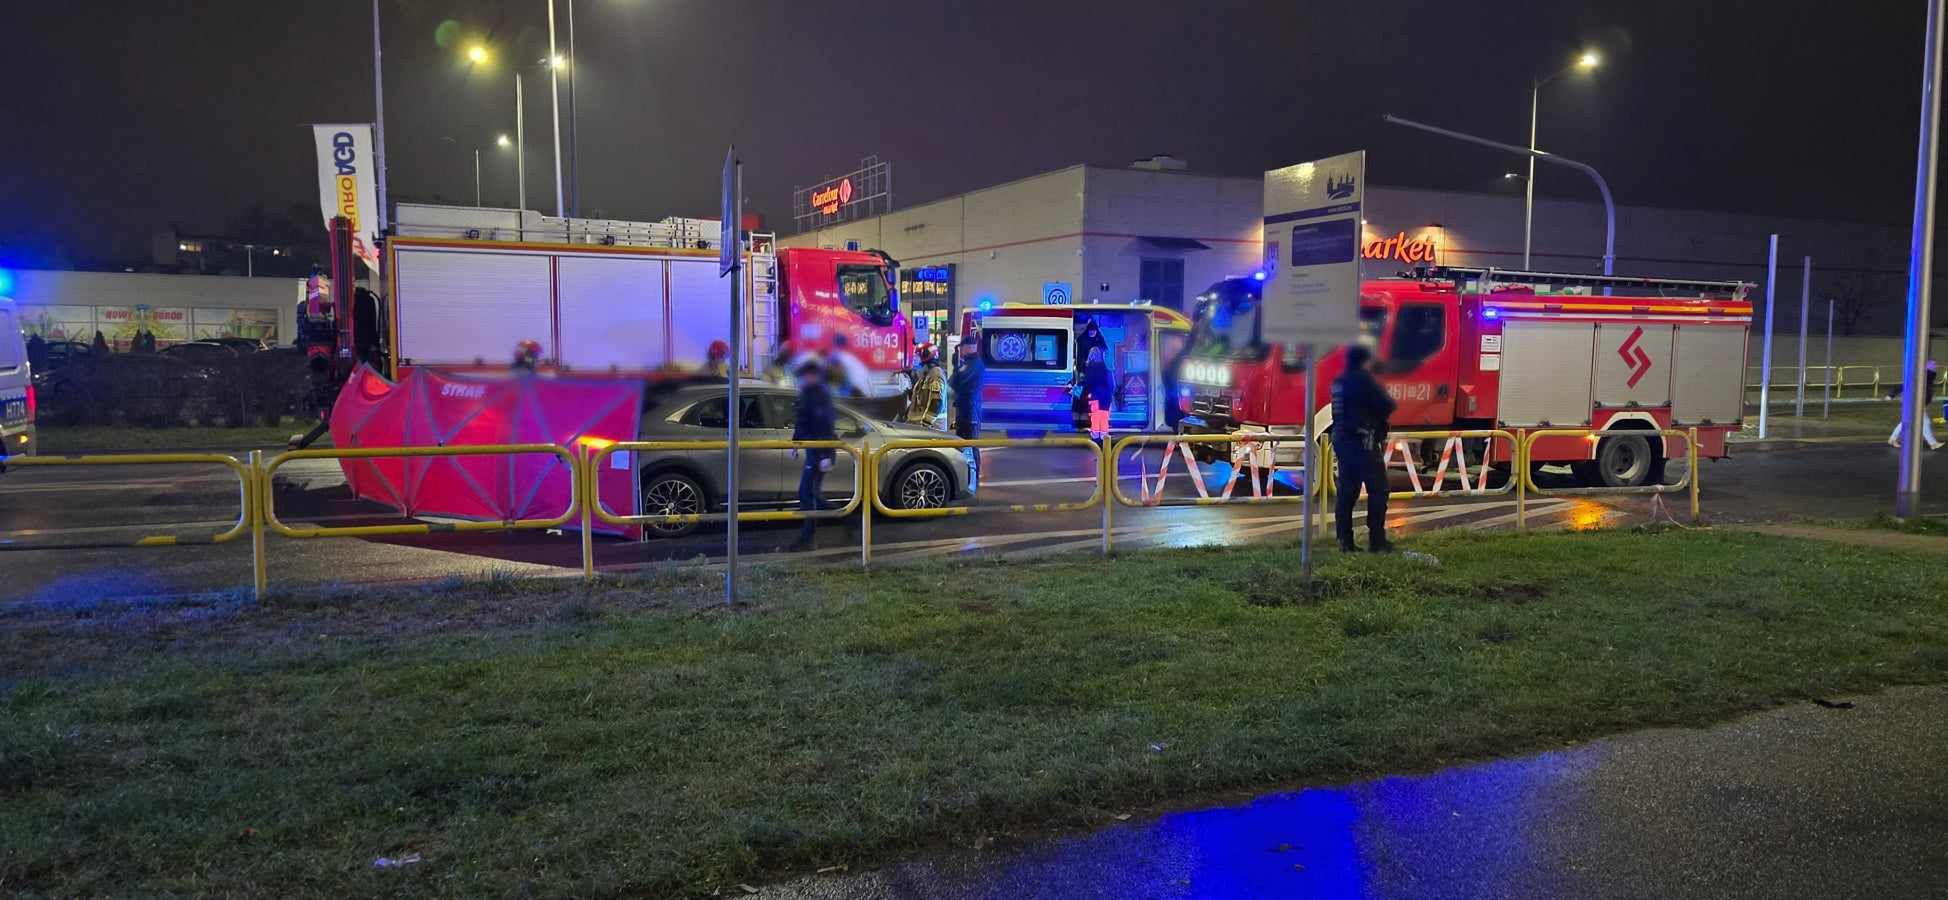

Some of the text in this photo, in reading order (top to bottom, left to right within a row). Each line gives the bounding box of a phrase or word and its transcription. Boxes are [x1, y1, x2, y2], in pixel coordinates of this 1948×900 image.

[1361, 231, 1436, 264] arket
[1051, 294, 1064, 305] 20
[883, 332, 899, 349] 43
[1416, 383, 1431, 401] 21
